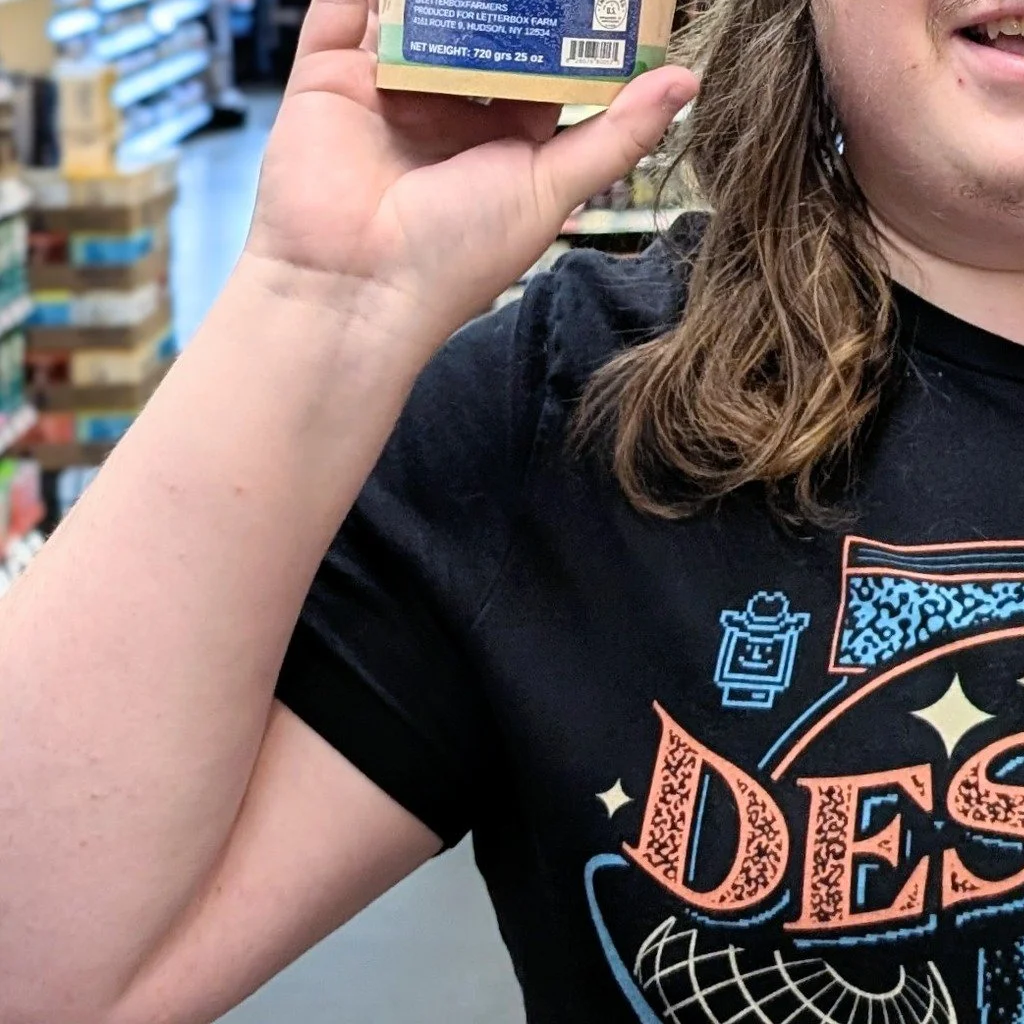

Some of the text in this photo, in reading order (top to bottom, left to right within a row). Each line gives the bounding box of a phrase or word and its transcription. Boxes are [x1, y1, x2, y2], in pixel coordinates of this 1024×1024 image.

[414, 6, 558, 26] PRODUCED FOR LETTERBOX FARM
[429, 18, 456, 29] ROUTE
[467, 22, 506, 34] HUDSON,
[509, 26, 523, 35] NY
[525, 27, 550, 36] 12534
[410, 42, 544, 63] NET WEIGHT: 720 grs 25 oz
